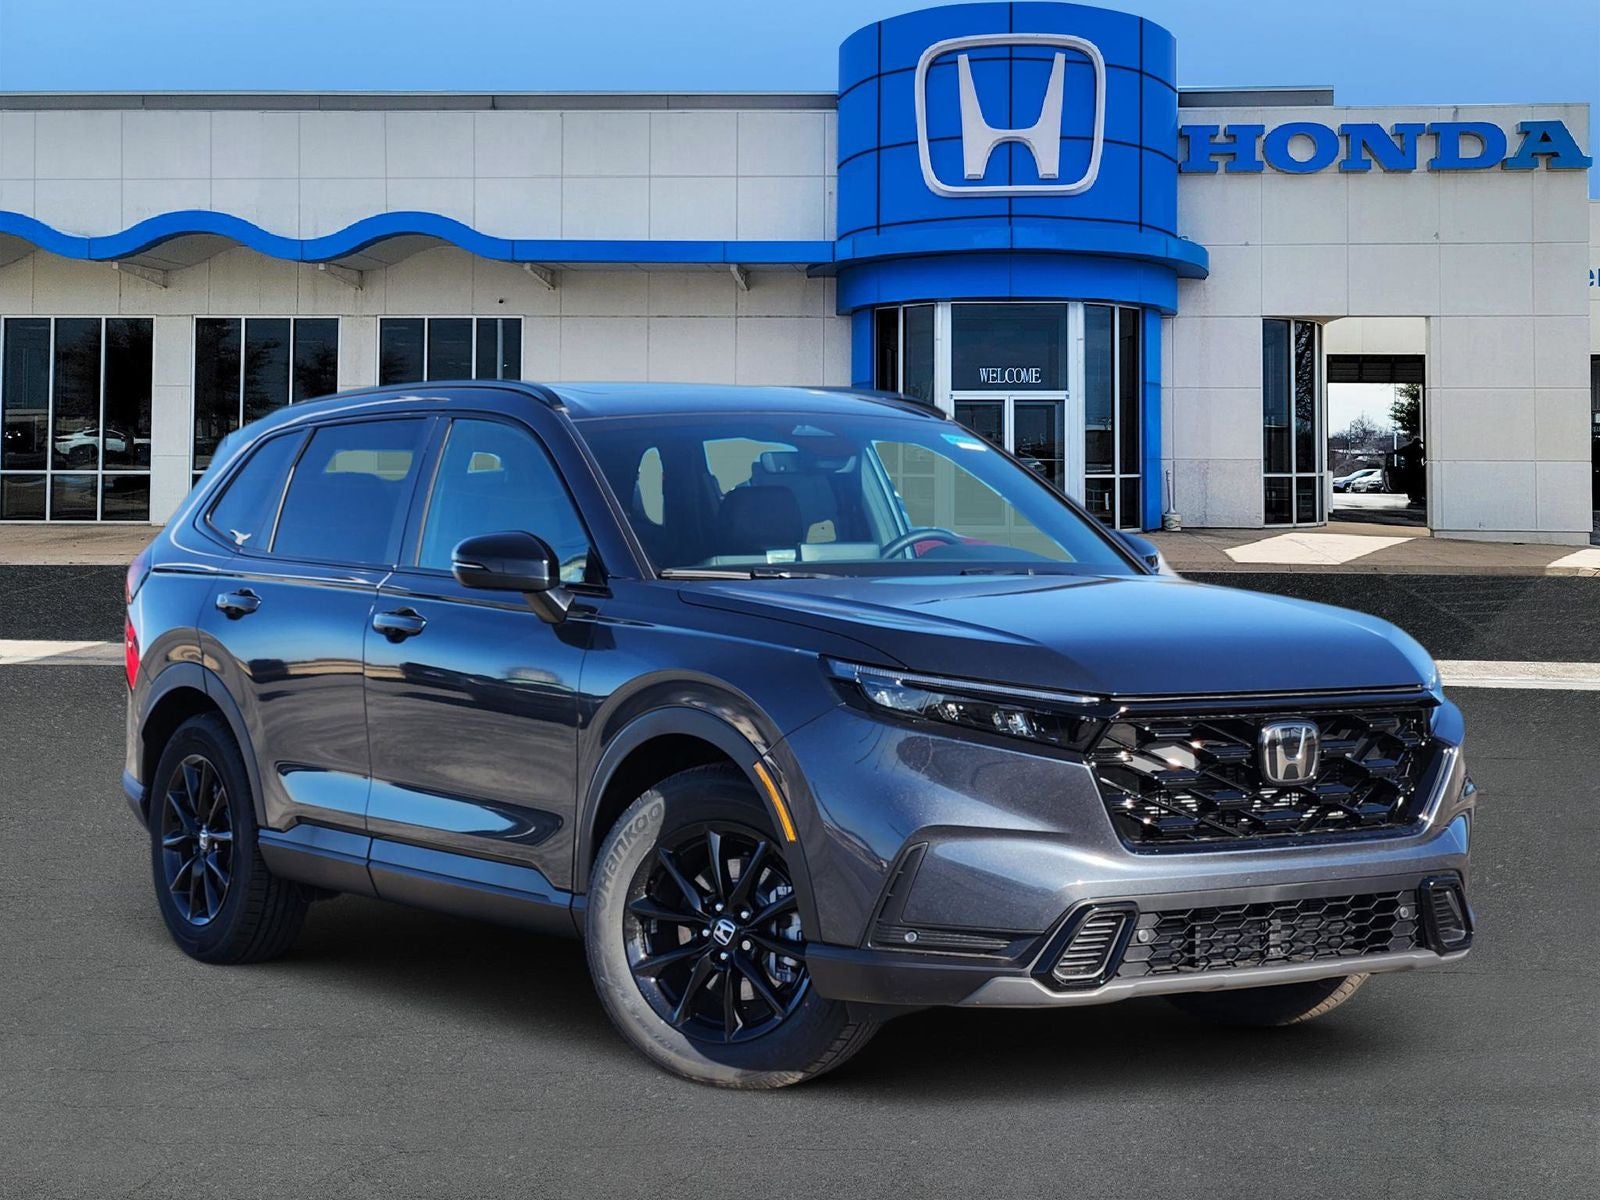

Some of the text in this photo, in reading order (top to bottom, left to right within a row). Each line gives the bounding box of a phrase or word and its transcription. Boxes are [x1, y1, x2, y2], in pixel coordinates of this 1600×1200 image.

[1179, 120, 1593, 174] HONDA
[979, 367, 1041, 384] WELCOME
[600, 802, 663, 893] Hankoo
